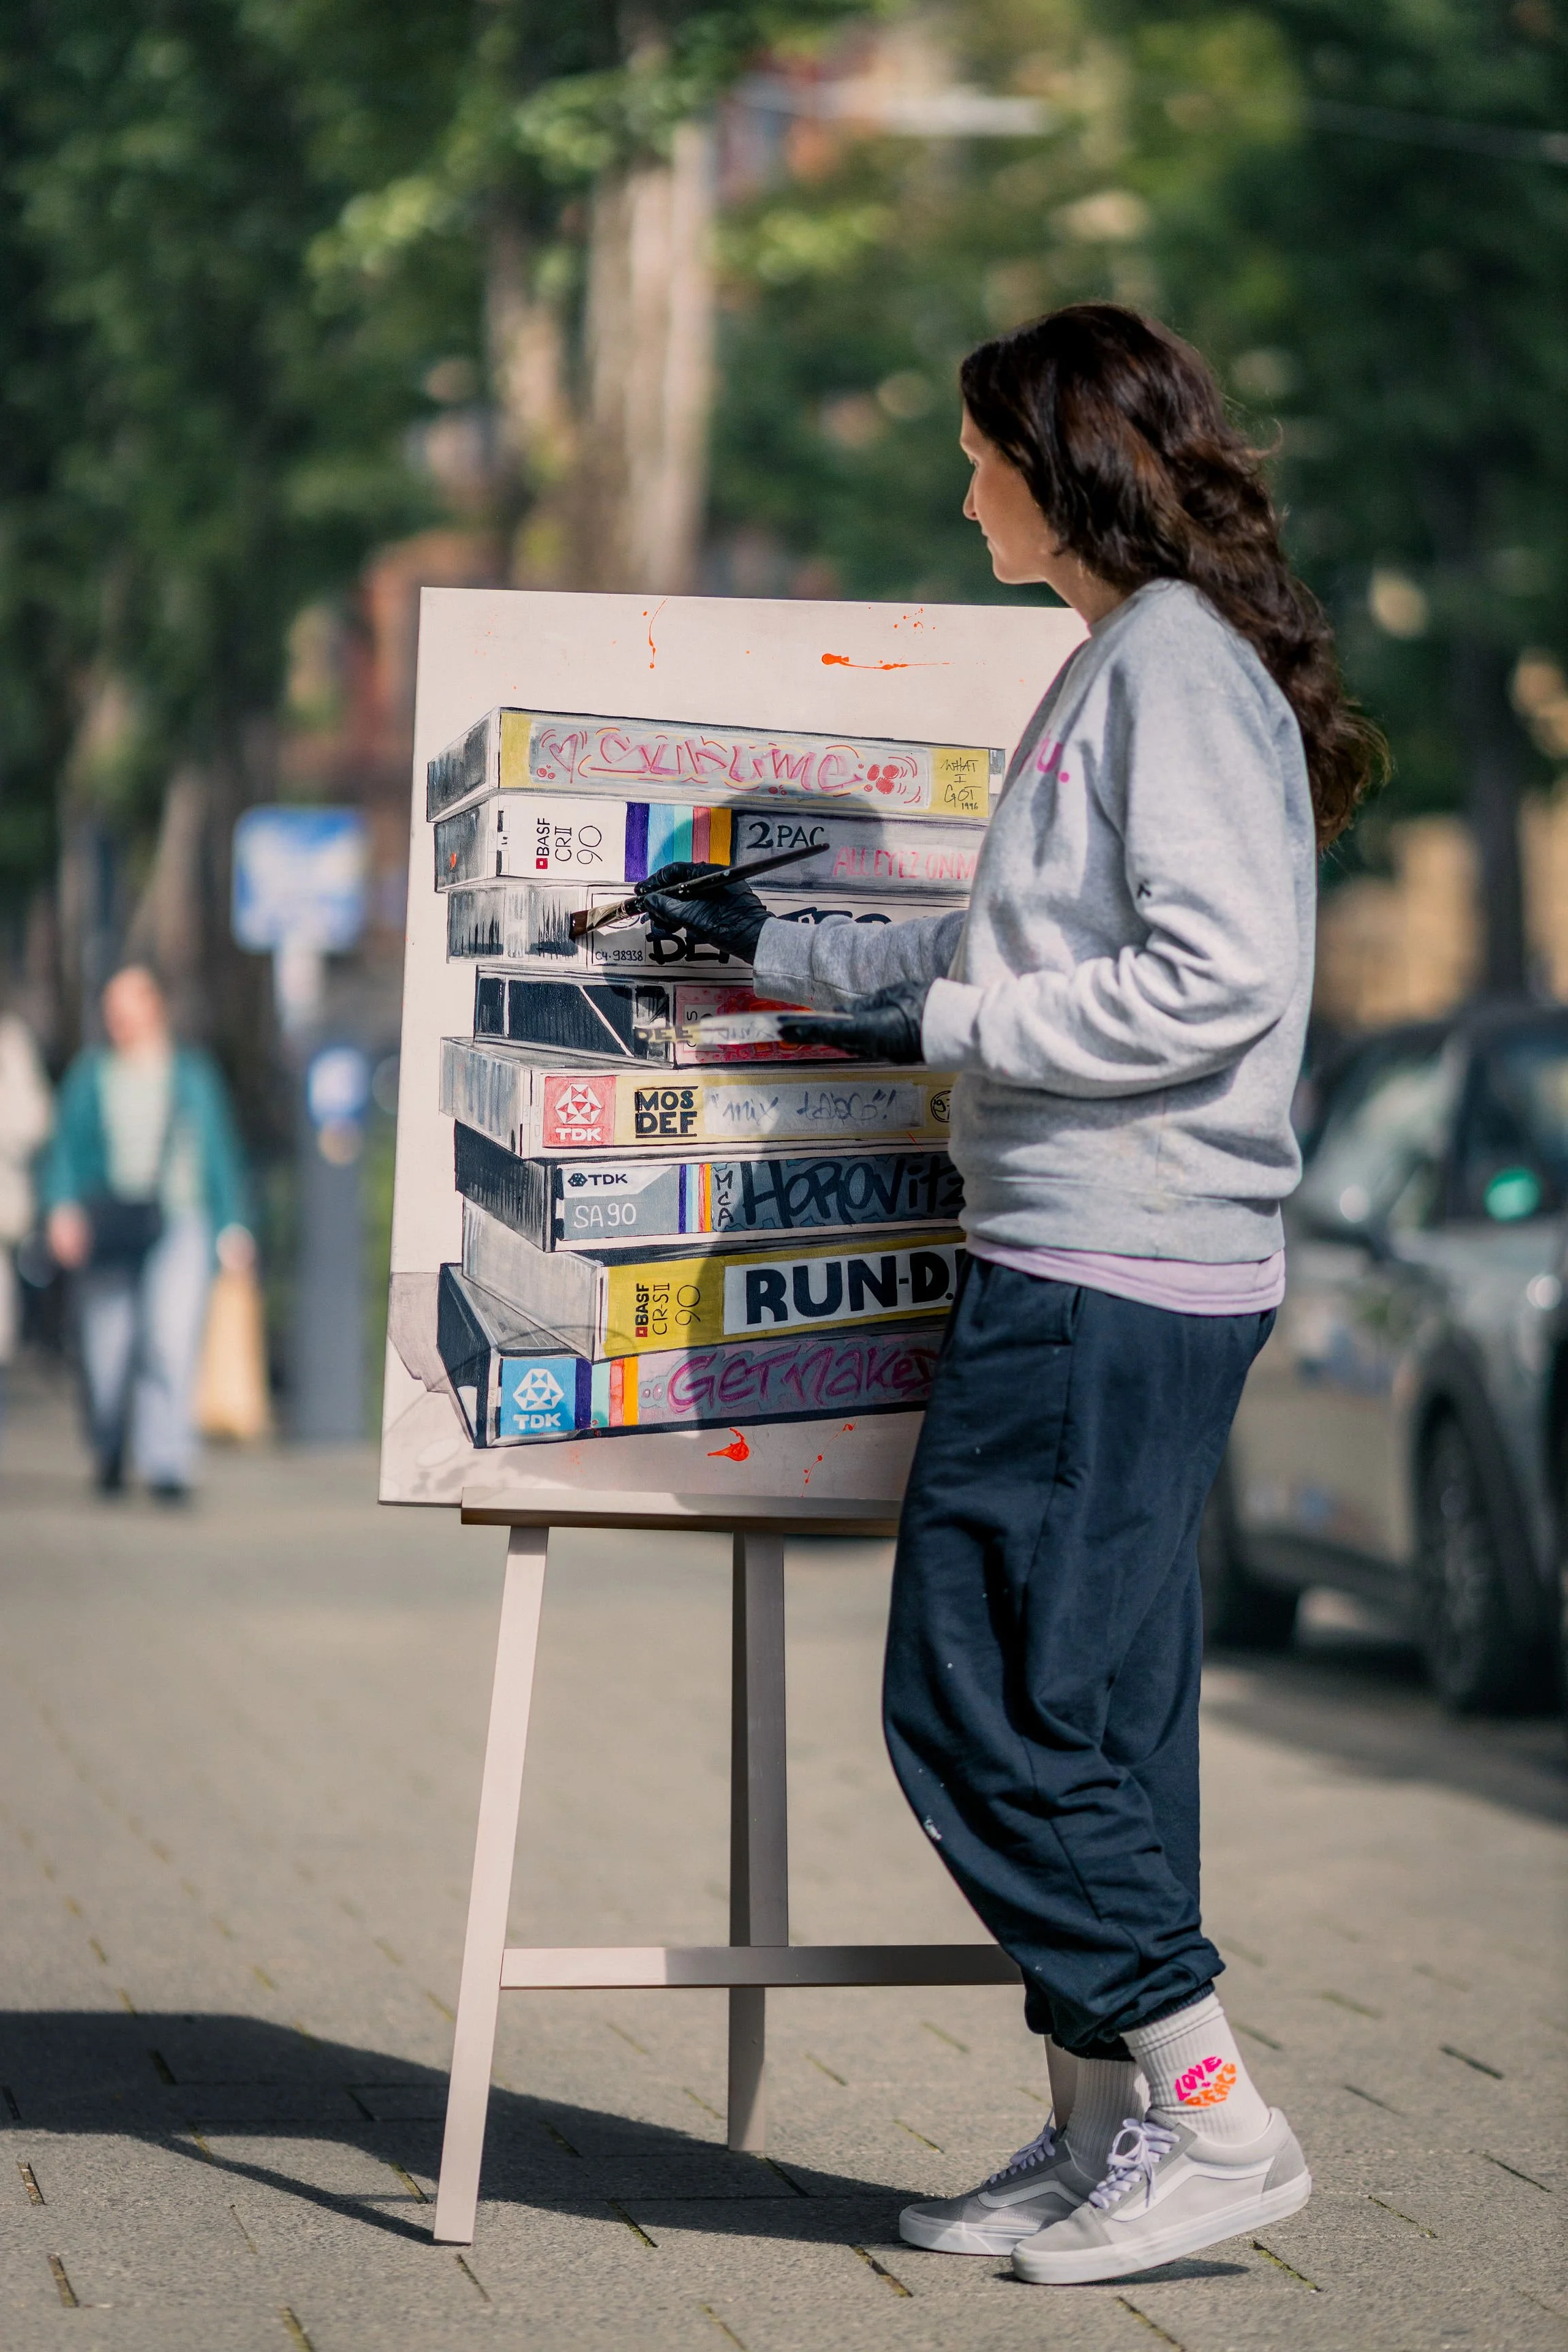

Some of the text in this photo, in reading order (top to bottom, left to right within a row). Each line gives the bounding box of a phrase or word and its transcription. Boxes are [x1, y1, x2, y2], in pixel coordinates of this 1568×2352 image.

[941, 757, 979, 772] WHAT
[954, 774, 966, 783] I
[945, 784, 981, 808] GOT
[536, 818, 550, 855] BASF
[577, 826, 603, 864] 90
[747, 821, 824, 849] 2PAC
[634, 1090, 694, 1111] MOS
[555, 1128, 602, 1141] TDK
[635, 1111, 698, 1134] DEF
[588, 1174, 627, 1186] TDK
[746, 1249, 966, 1325] RUN-D.
[636, 1284, 649, 1325] BASF
[675, 1285, 701, 1325] 90
[512, 1413, 561, 1430] TDK
[1175, 2056, 1222, 2101] LOVE
